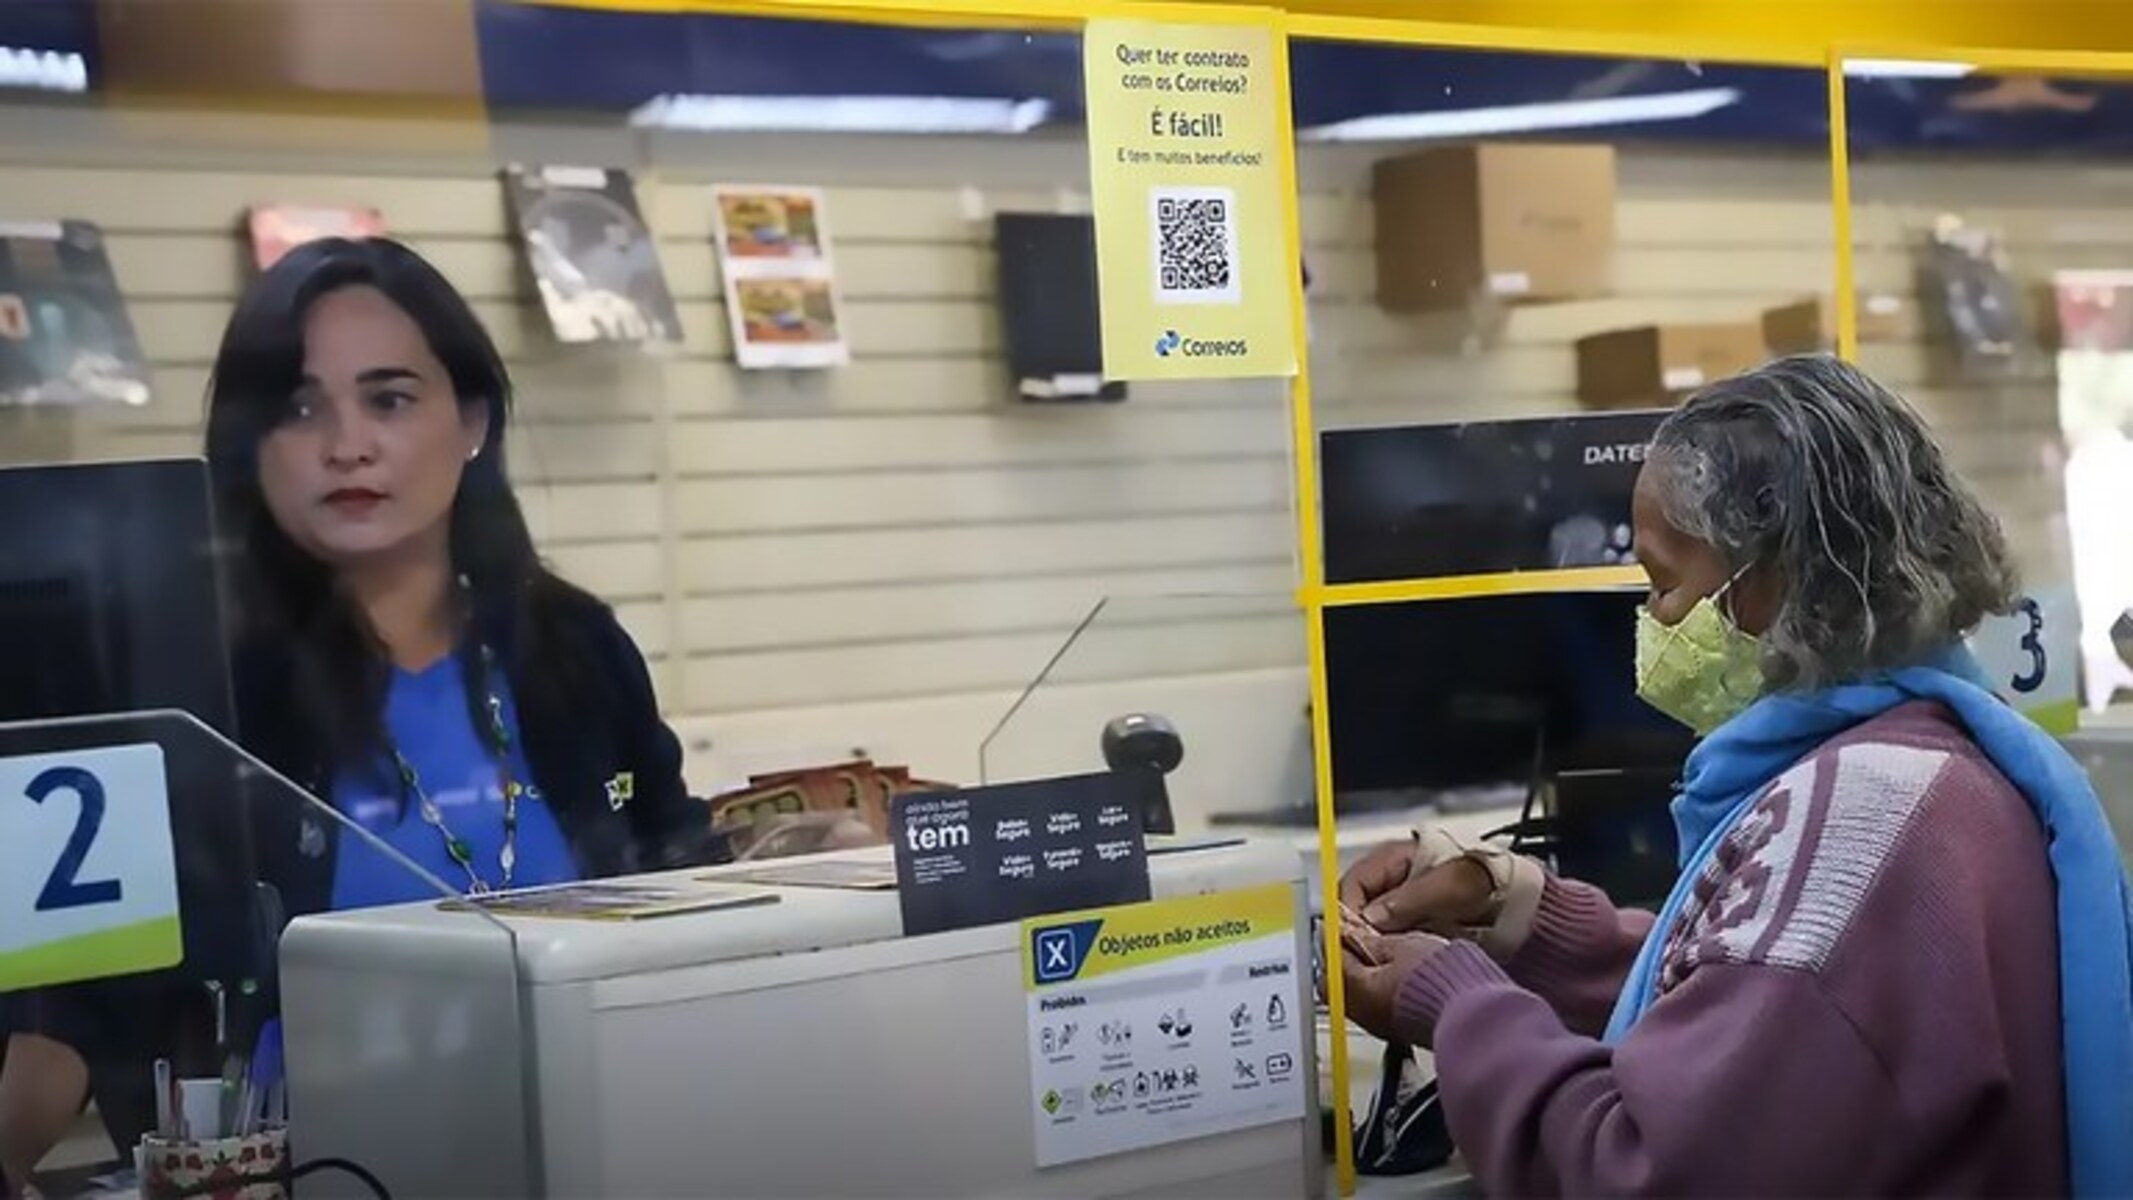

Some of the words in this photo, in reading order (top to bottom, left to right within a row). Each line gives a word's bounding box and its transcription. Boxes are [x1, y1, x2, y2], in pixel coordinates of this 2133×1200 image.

[1116, 43, 1152, 65] Quer
[1156, 49, 1178, 65] ter
[1184, 52, 1250, 67] contrato
[1122, 74, 1152, 88] com
[1156, 77, 1172, 90] os
[1175, 73, 1248, 93] Correios?
[1151, 106, 1163, 135] É
[1170, 111, 1223, 137] fácil!
[1117, 148, 1126, 162] E
[1128, 150, 1150, 163] tem
[1155, 151, 1192, 164] muitos
[1182, 338, 1247, 357] Correios
[2011, 597, 2046, 693] 3
[24, 766, 122, 912] 2
[906, 824, 970, 851] tem
[1099, 932, 1160, 957] Objetos
[1164, 925, 1192, 945] não
[1197, 919, 1251, 942] aceitos
